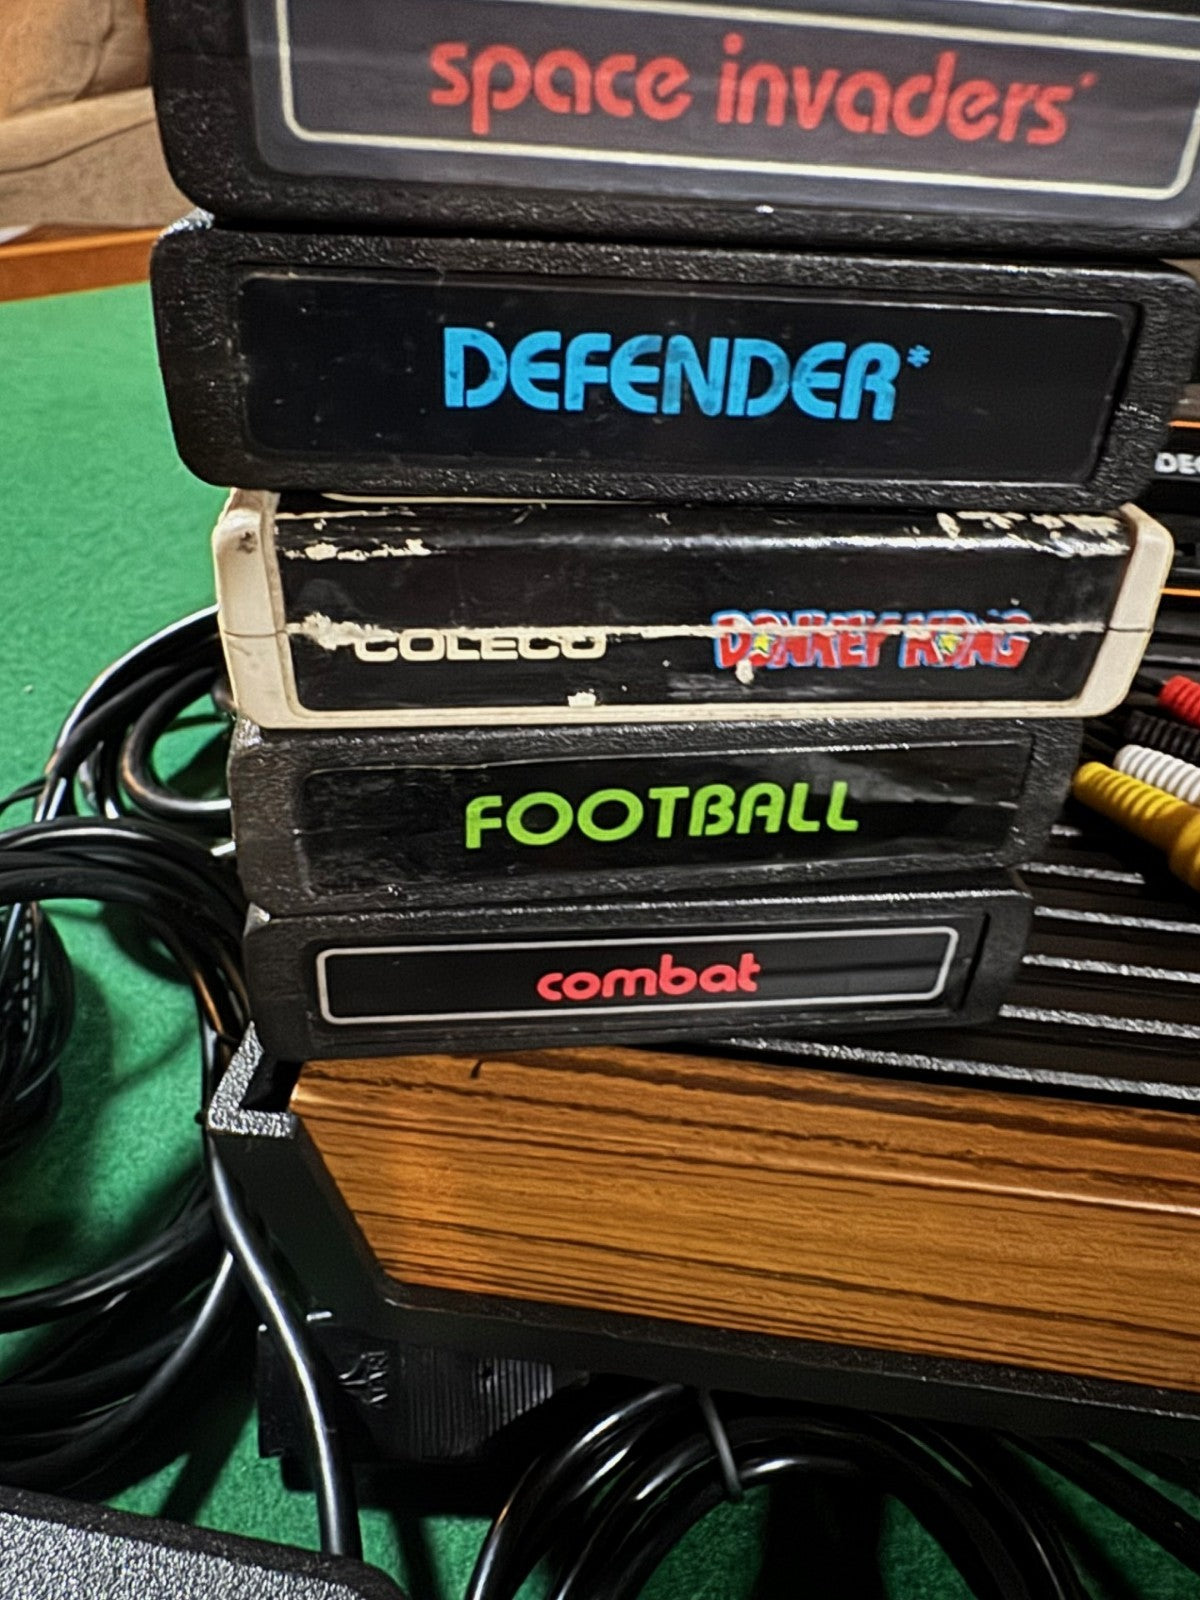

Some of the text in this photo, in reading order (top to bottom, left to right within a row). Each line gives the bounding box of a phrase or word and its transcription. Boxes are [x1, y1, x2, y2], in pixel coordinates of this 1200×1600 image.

[430, 42, 693, 135] space
[1154, 452, 1200, 475] DE
[354, 609, 1031, 669] COLECO DONKEY KONG
[465, 781, 860, 849] FOOTBALL
[536, 952, 762, 1002] combat
